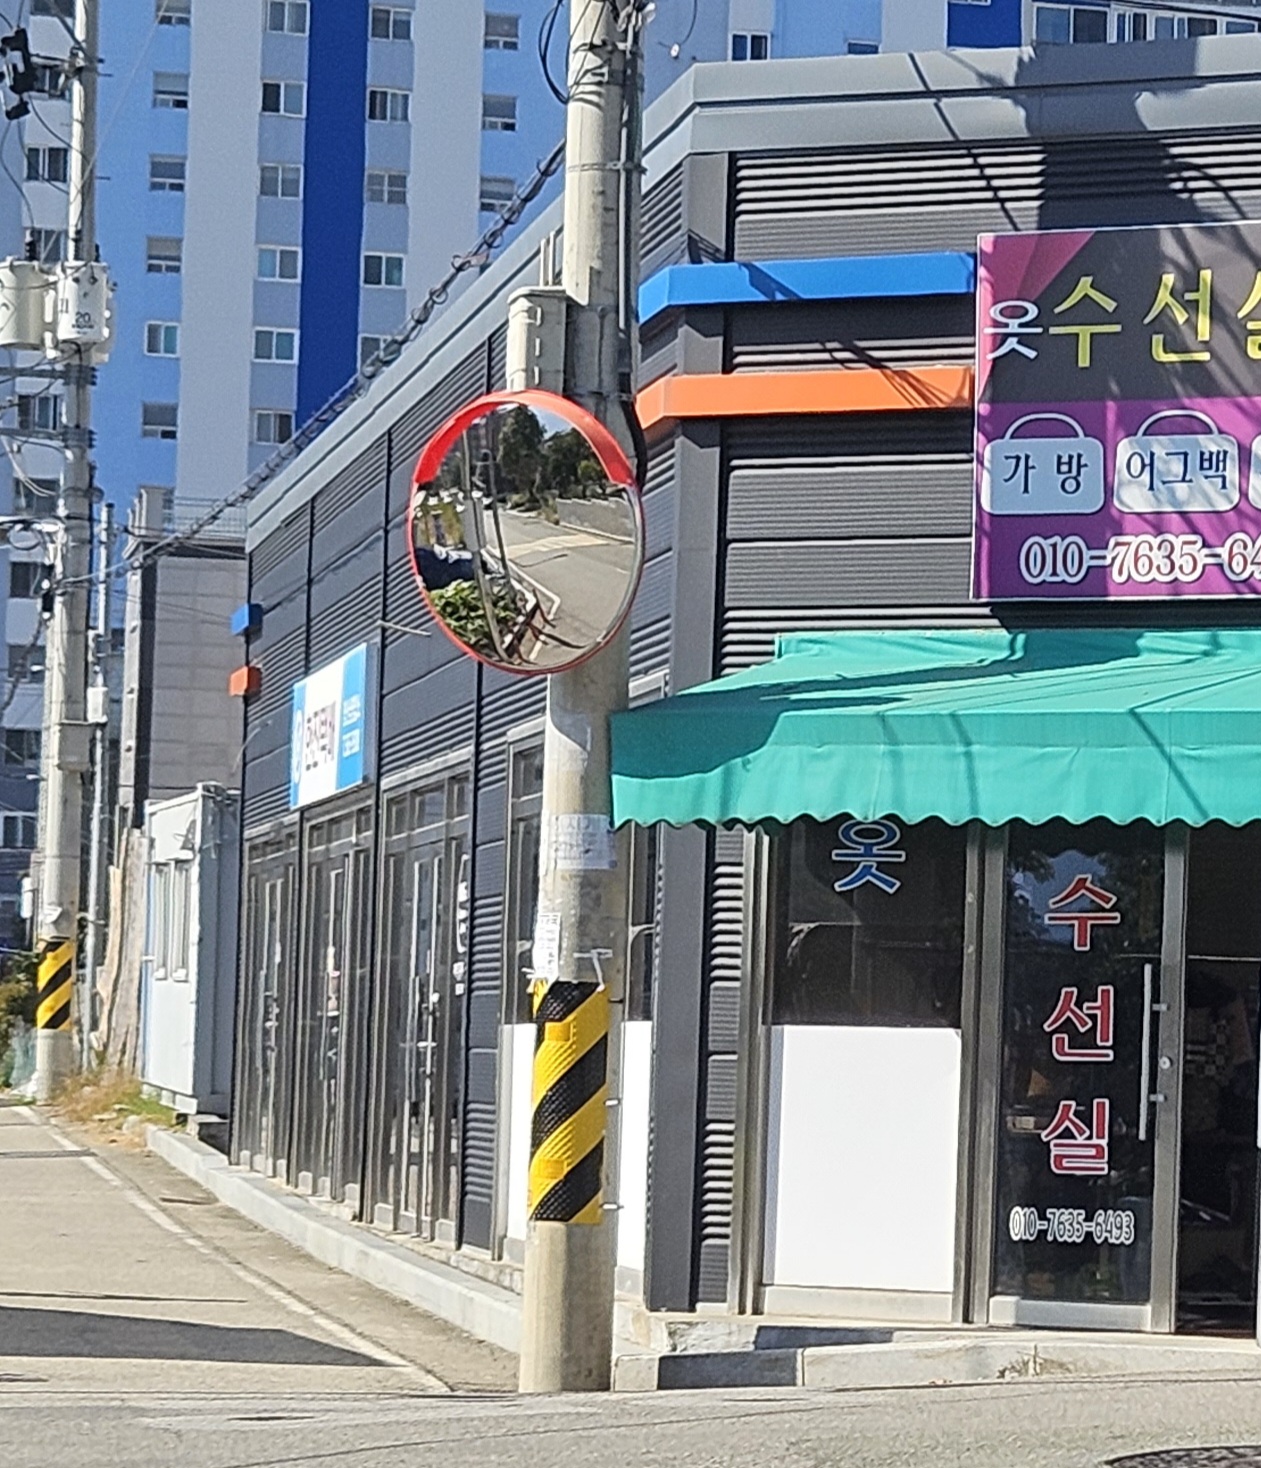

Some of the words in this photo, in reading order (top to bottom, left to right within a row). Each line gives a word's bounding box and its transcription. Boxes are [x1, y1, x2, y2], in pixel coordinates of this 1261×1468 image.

[1125, 448, 1230, 492] 어그백
[831, 818, 906, 894] 옷
[1009, 1205, 1135, 1245] 010-7635-6493
